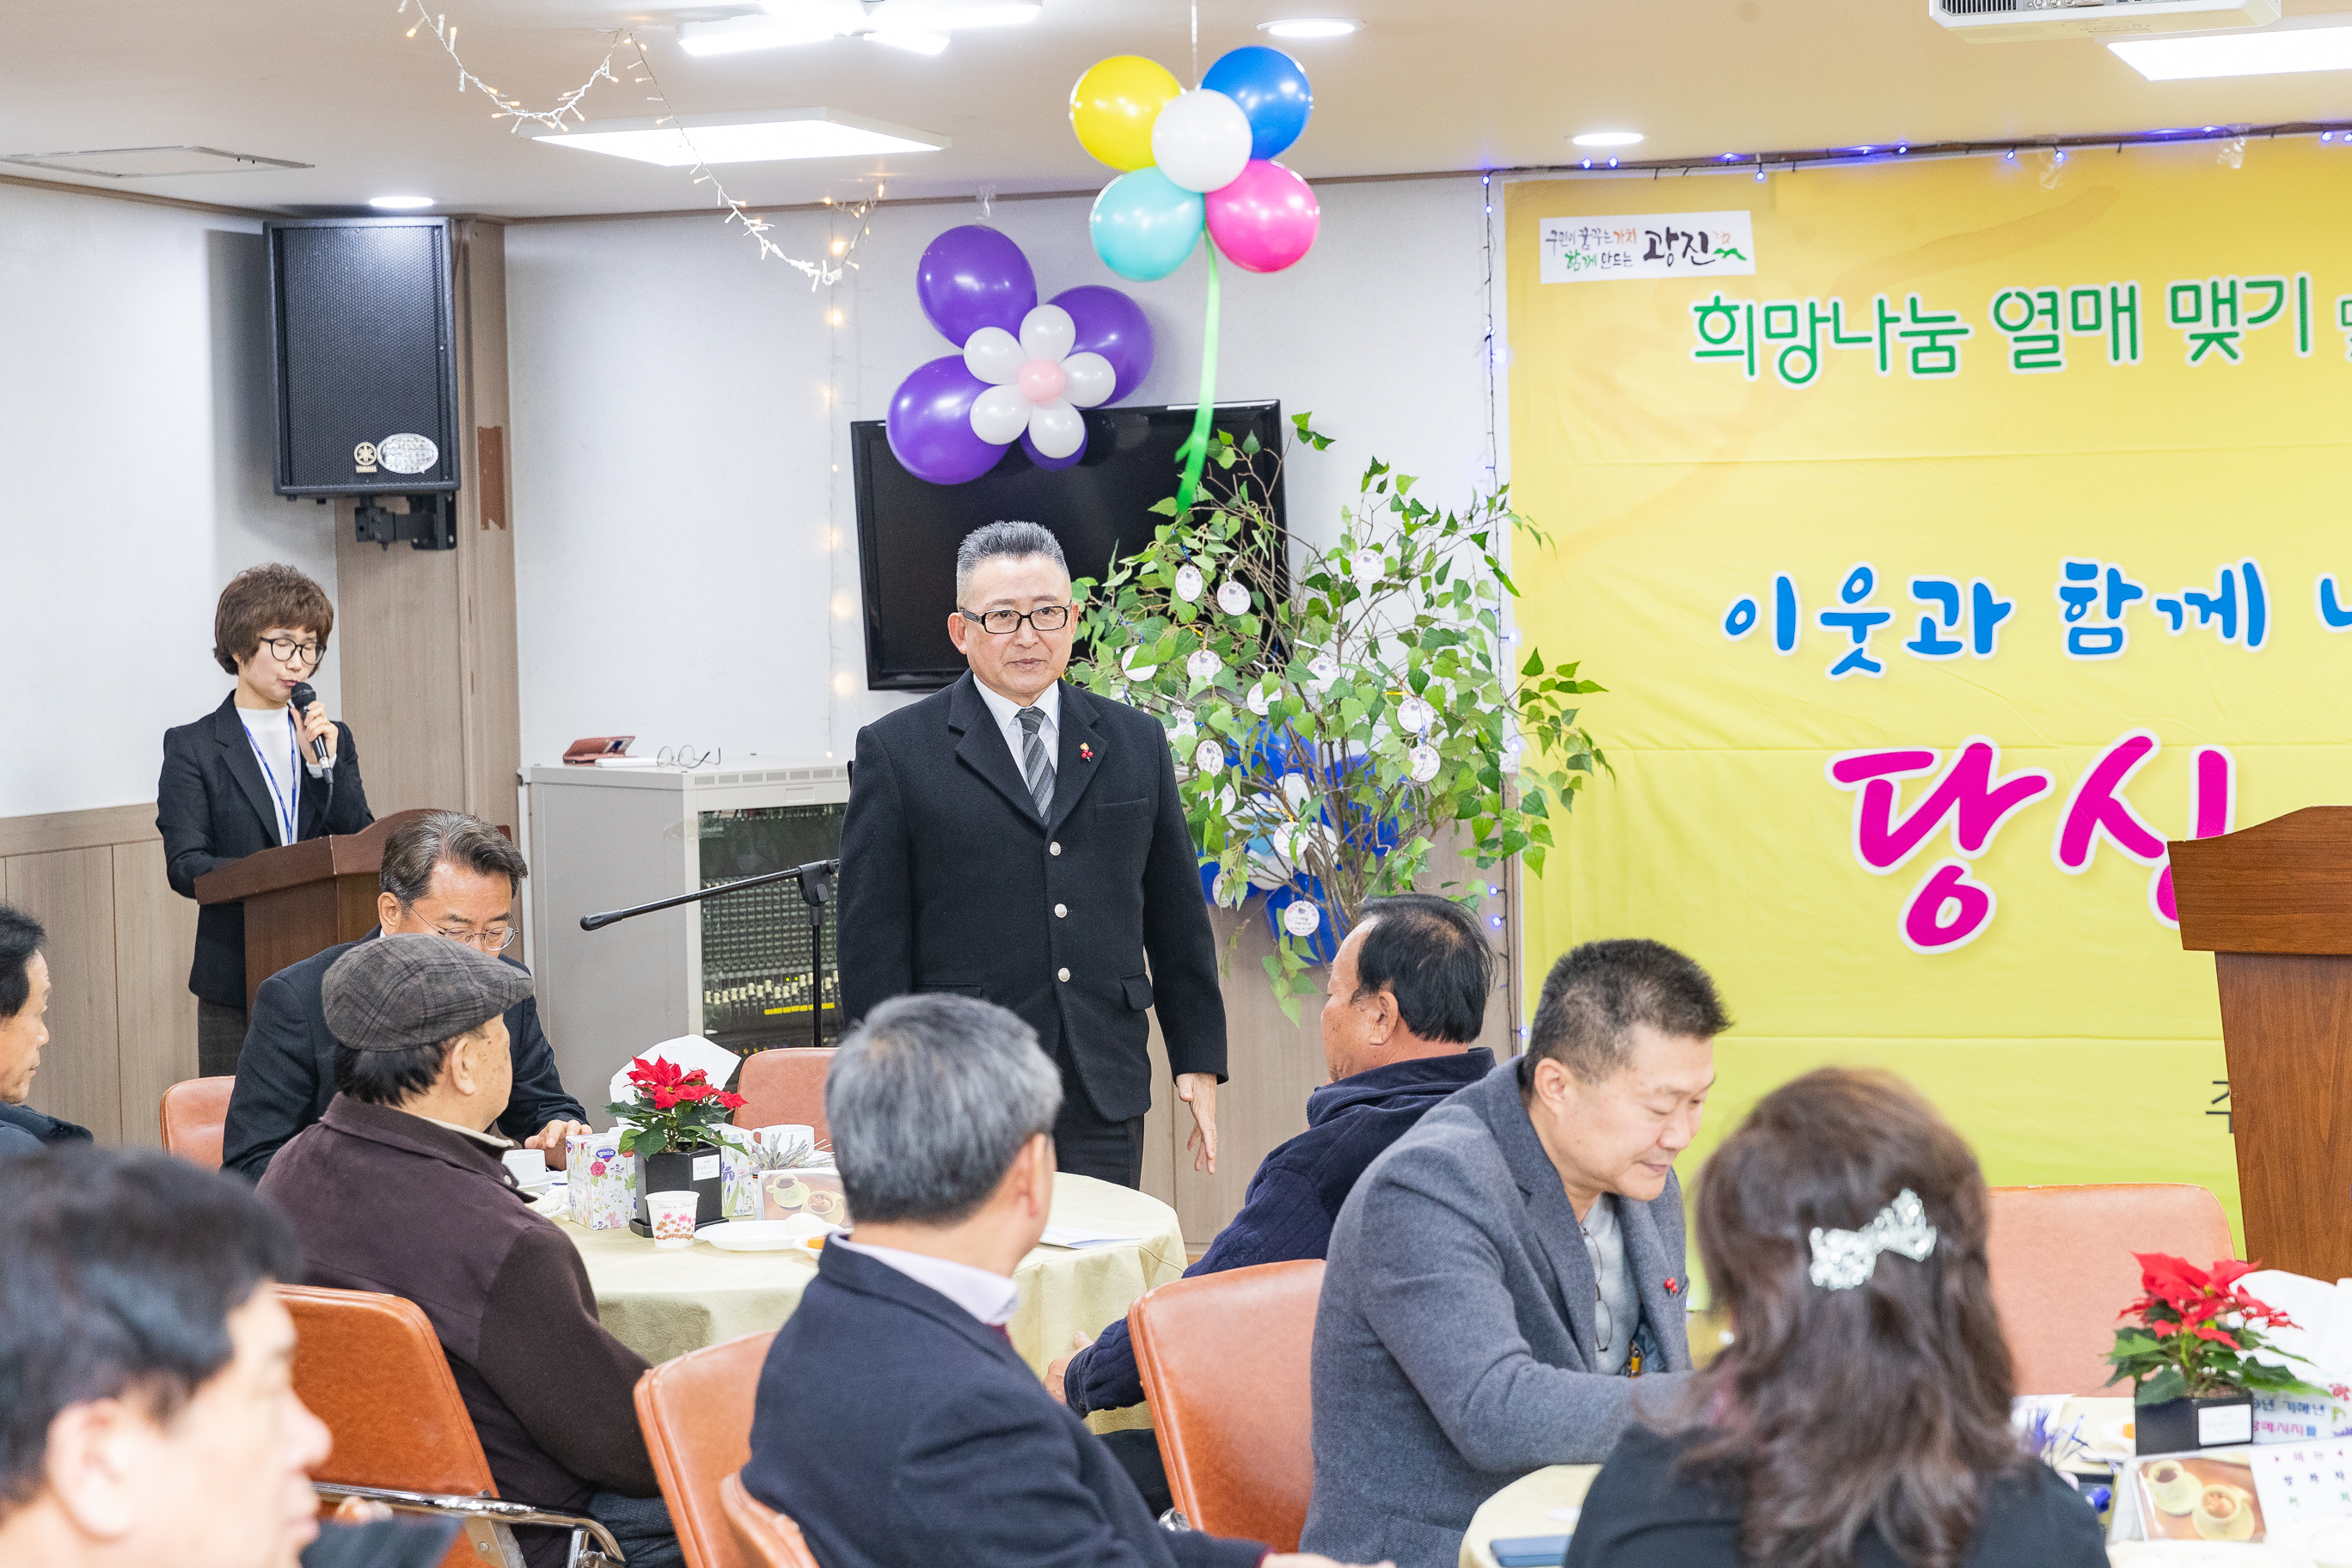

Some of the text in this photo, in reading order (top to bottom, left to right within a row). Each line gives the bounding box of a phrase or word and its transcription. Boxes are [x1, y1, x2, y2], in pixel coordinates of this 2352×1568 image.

[1565, 248, 1633, 272] 함께 만드는
[1642, 225, 1717, 267] 광진
[1692, 293, 1971, 386] 희망나눔
[1992, 284, 2139, 371] 열매
[2169, 275, 2309, 363] 맺기
[1724, 565, 2013, 677] 이웃과
[2057, 560, 2267, 657] 함께
